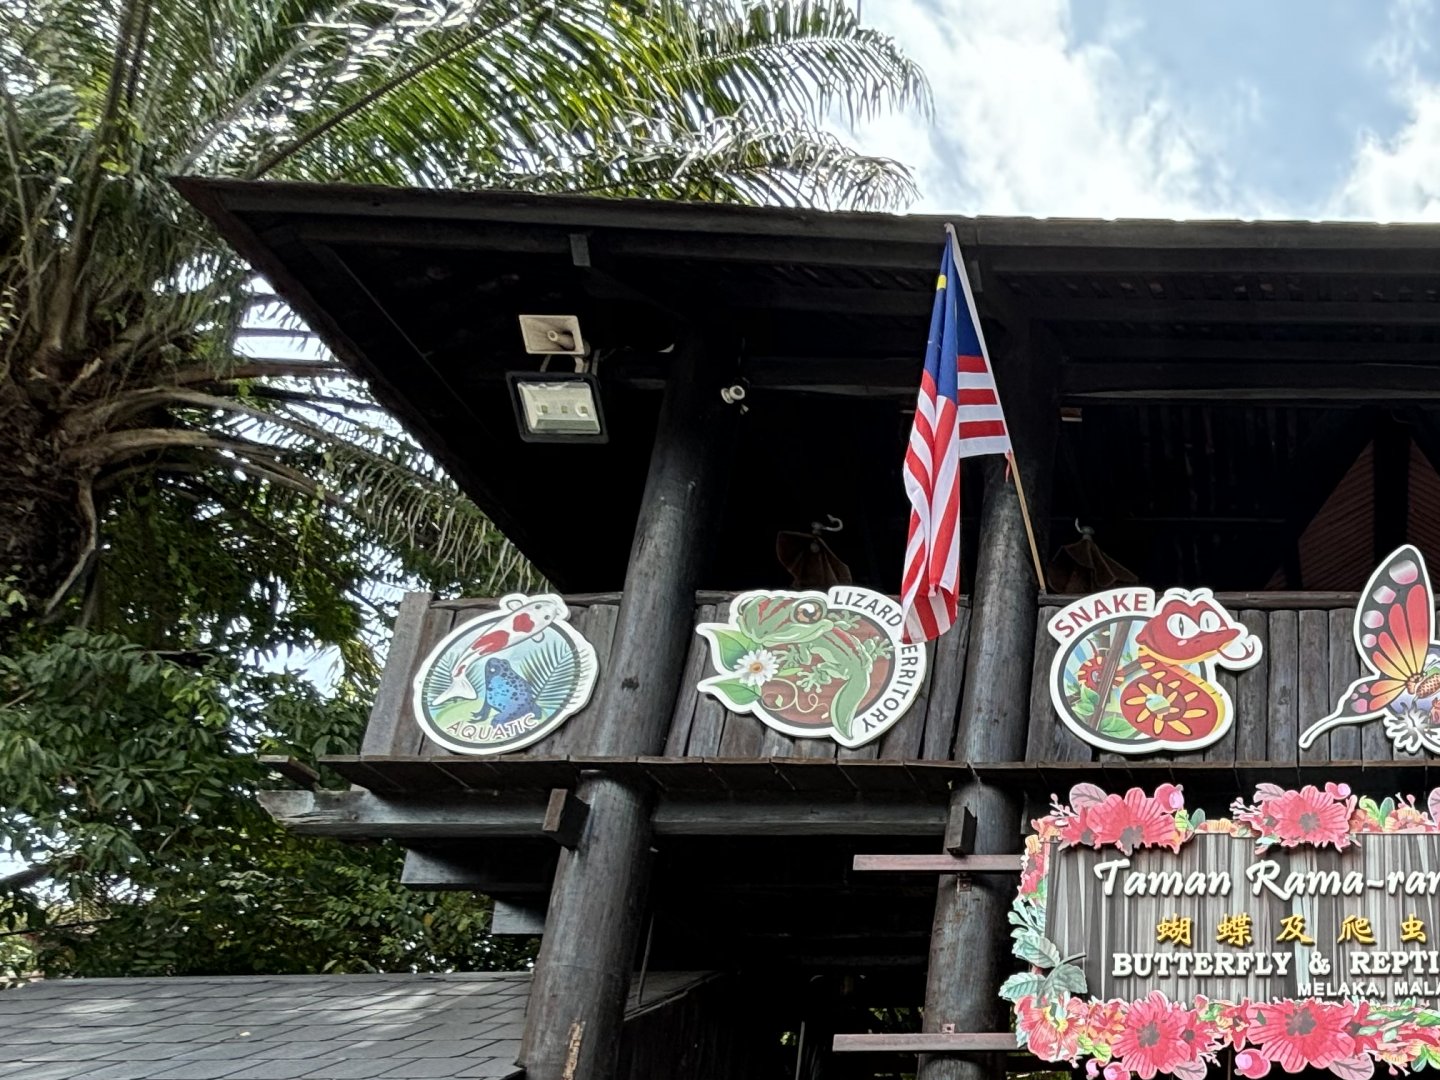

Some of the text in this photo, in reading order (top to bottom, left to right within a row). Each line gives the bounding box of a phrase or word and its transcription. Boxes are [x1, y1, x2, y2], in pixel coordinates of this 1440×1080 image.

[1054, 593, 1147, 638] SNAKE
[834, 591, 918, 732] LIZARD ERRITORY
[447, 711, 539, 740] AQUATIC
[1093, 857, 1232, 897] Taman
[1111, 951, 1293, 977] BUTTERFLY
[1308, 951, 1331, 977] &
[1297, 981, 1386, 998] MELAKA,
